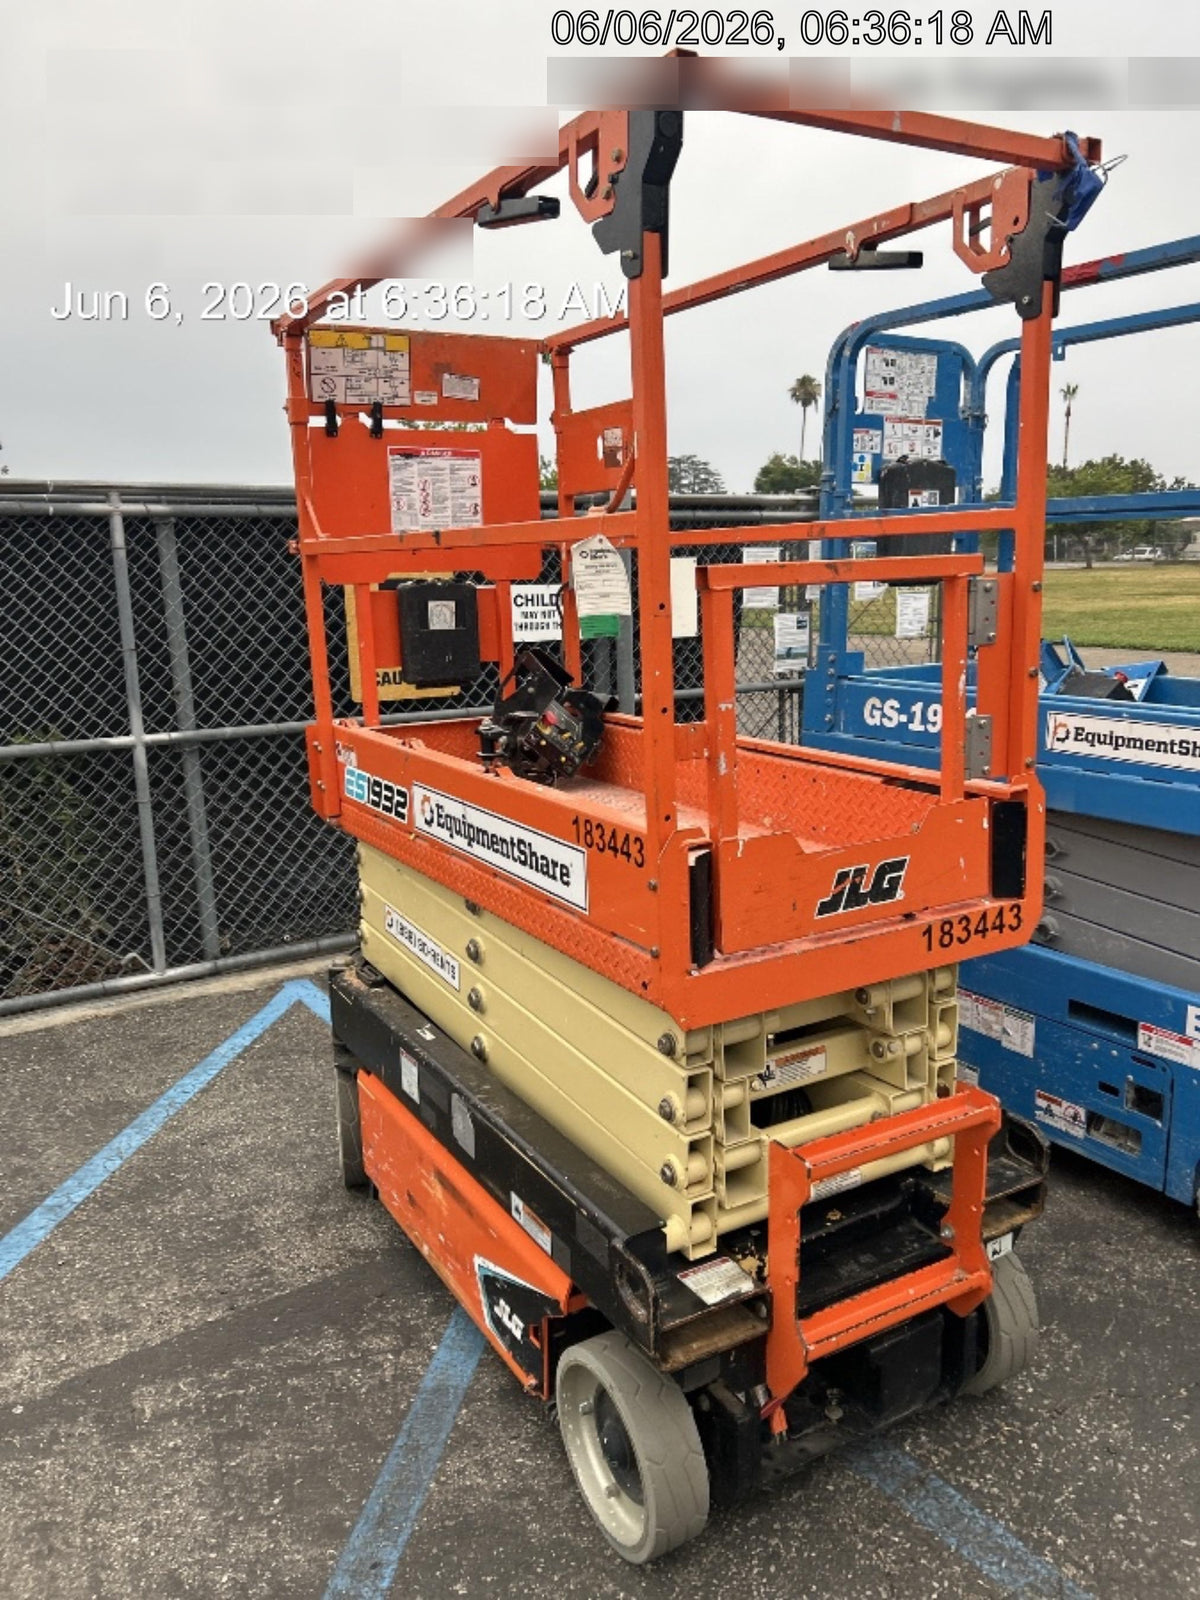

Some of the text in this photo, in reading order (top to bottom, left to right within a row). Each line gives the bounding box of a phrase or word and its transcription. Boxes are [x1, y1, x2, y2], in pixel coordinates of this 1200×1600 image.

[435, 802, 571, 888] EquipmentShare
[572, 815, 645, 868] 183443
[815, 856, 909, 918] JLG
[922, 902, 1022, 952] 183443
[493, 1298, 525, 1341] JLG
